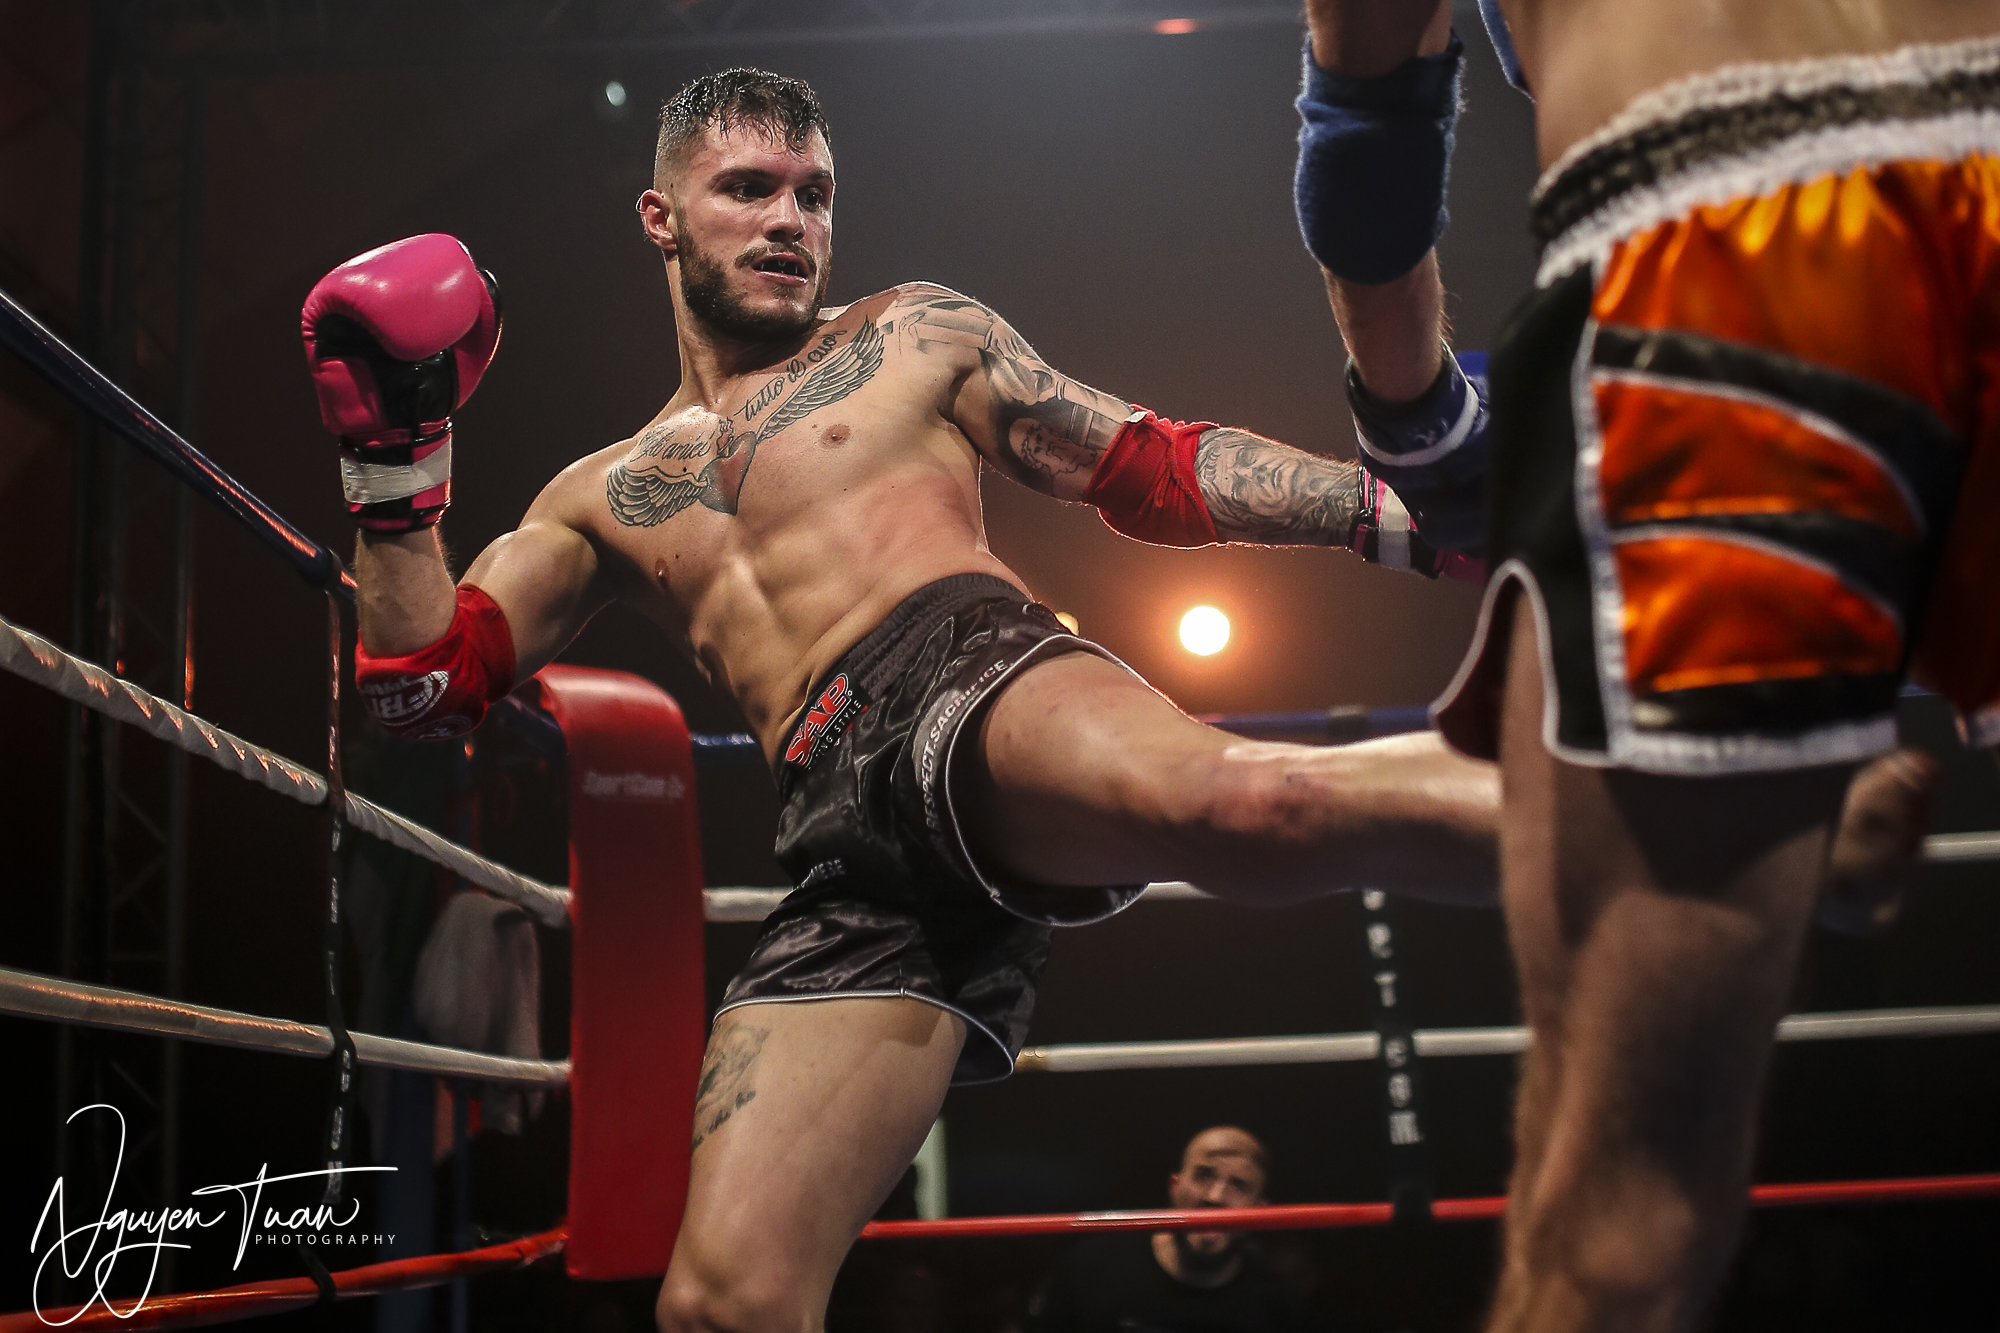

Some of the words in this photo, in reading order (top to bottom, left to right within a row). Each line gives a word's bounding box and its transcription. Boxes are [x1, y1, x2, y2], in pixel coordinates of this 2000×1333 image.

[733, 374, 786, 422] tutto
[786, 358, 807, 384] il
[834, 699, 862, 734] STYLE
